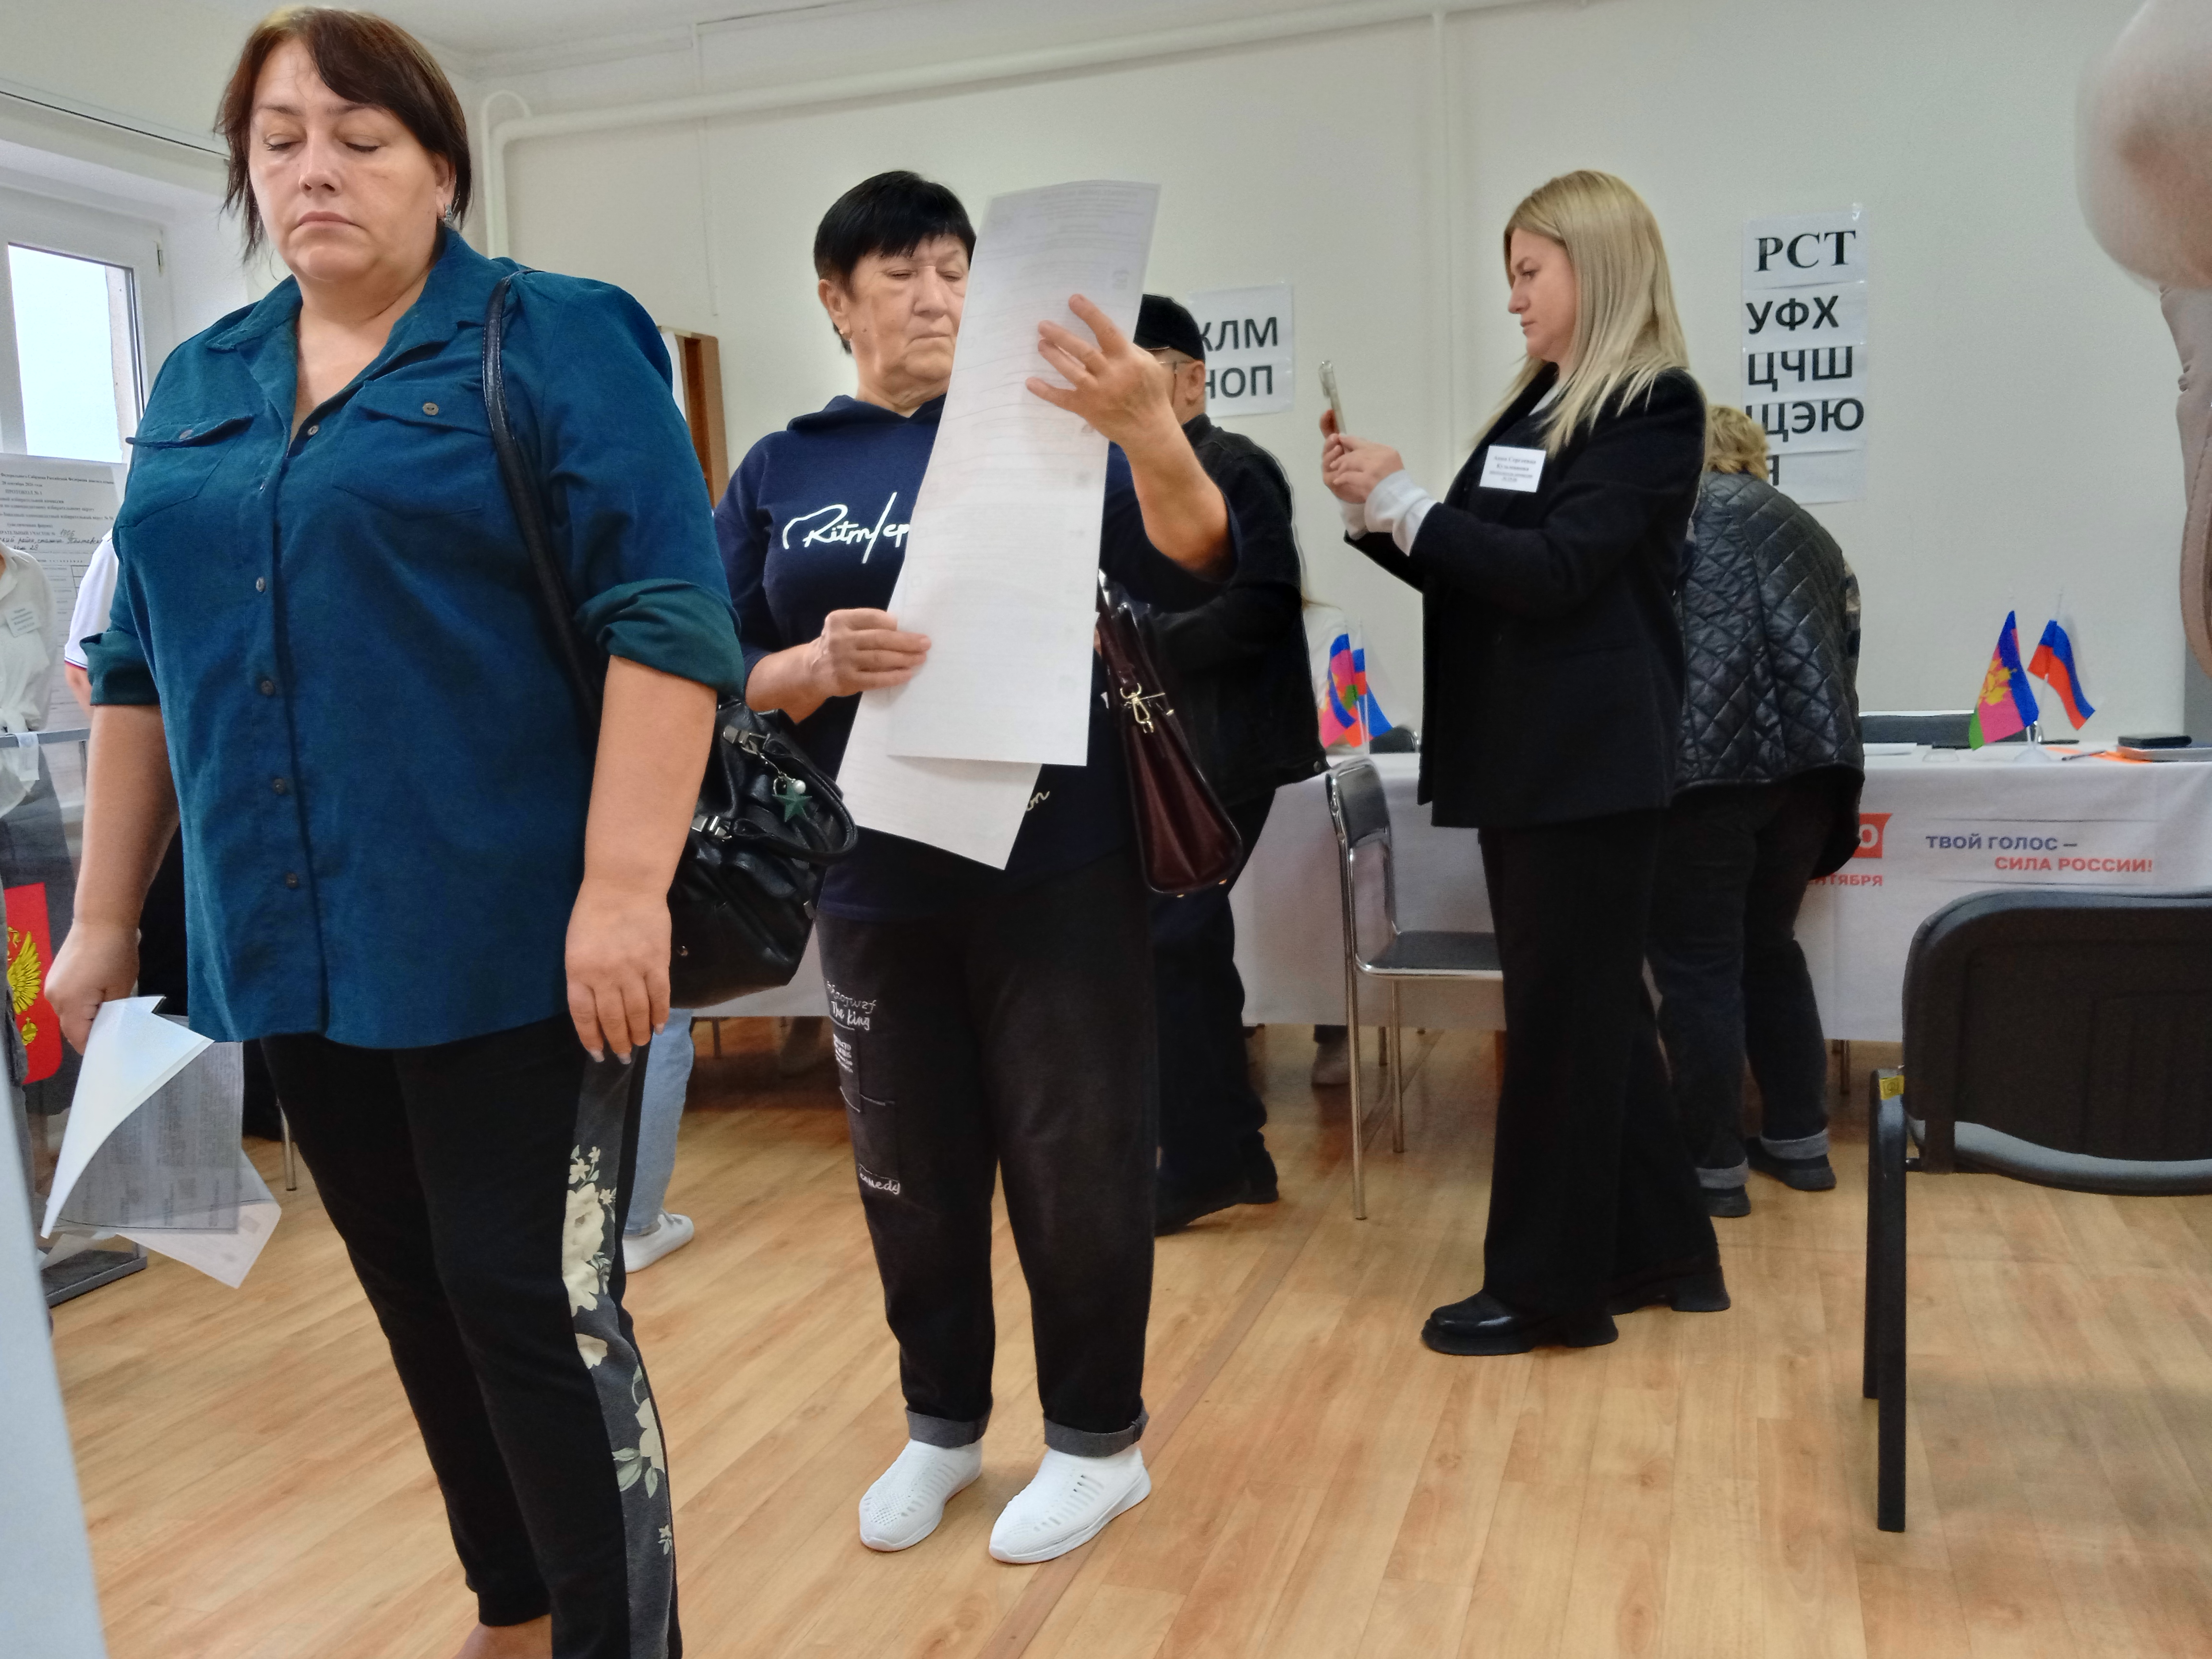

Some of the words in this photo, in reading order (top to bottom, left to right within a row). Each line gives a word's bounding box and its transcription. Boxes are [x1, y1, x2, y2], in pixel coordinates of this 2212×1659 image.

[1754, 229, 1856, 272] РСТ
[1745, 295, 1839, 335] УФХ
[1748, 346, 1852, 392] ЦЧШ
[1745, 398, 1864, 442] ЩЭЮ
[1925, 833, 1982, 849] ТВОЙ
[1988, 836, 2058, 851] ГОЛОС
[1809, 874, 1883, 886] НТЯБРЯ
[1994, 856, 2052, 870] СИЛА
[2057, 857, 2152, 872] РОССИИ!
